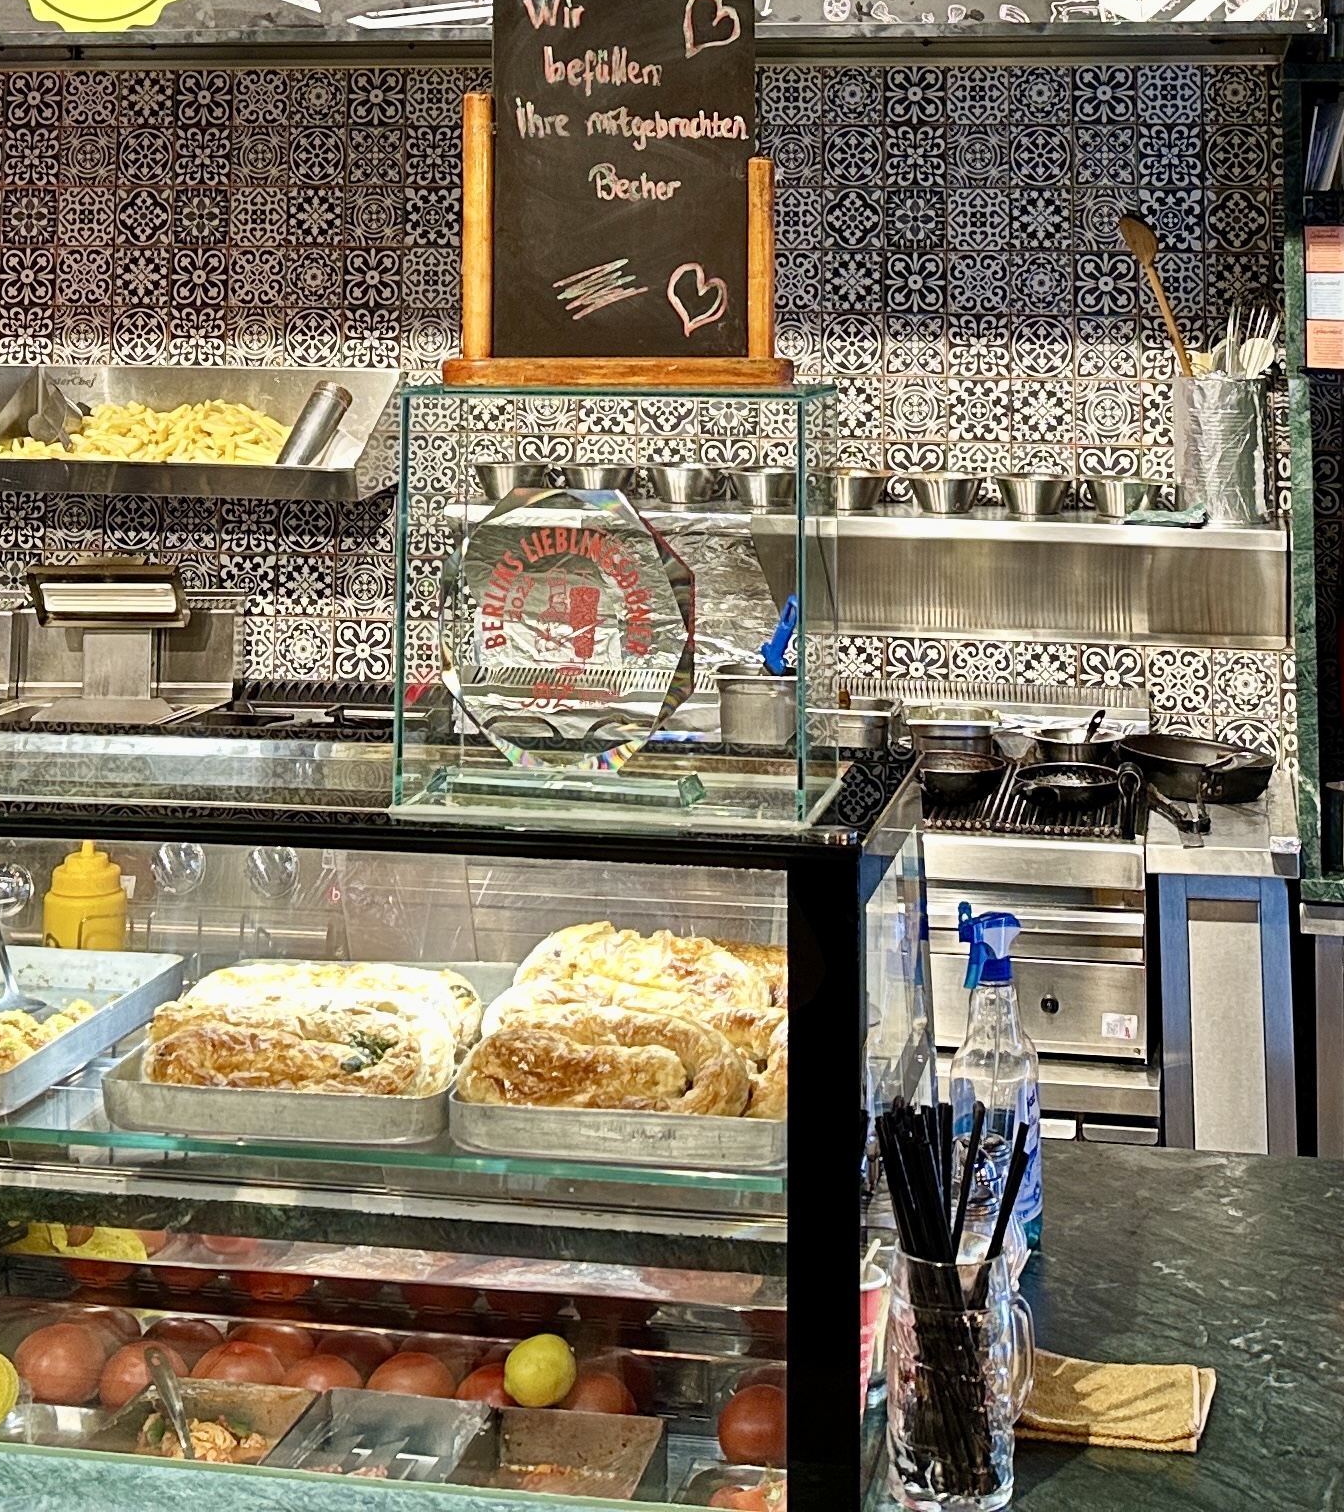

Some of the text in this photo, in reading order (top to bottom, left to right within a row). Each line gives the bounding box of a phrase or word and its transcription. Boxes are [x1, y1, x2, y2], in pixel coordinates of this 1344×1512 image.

[544, 45, 662, 97] befüllen
[585, 106, 749, 152] mitgebrachten
[588, 162, 682, 202] Becher
